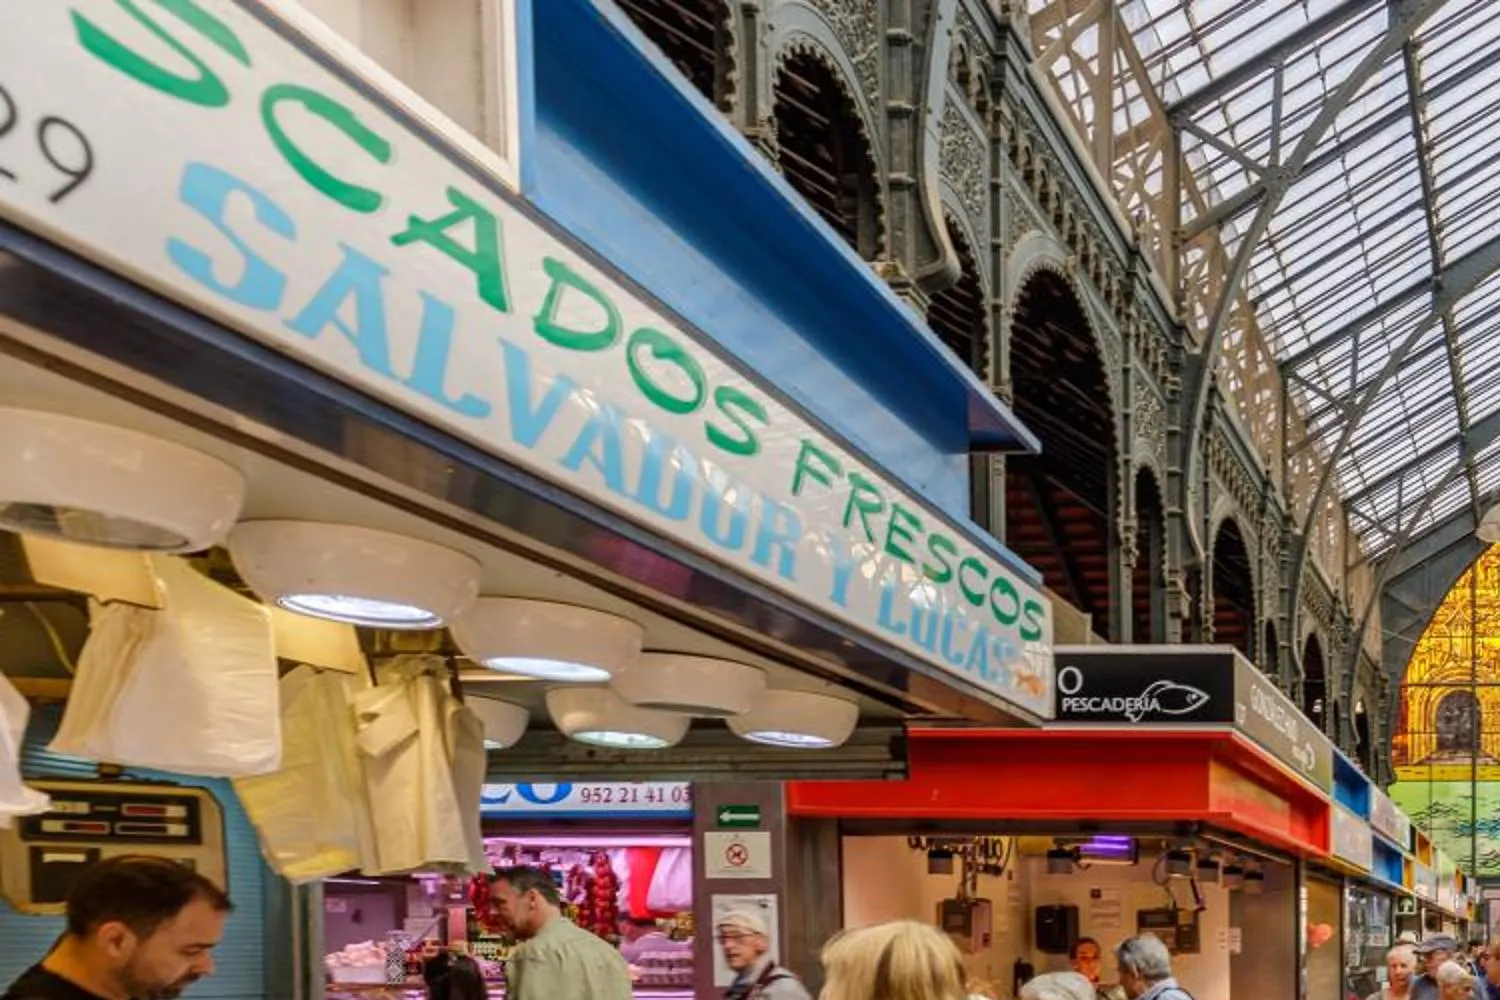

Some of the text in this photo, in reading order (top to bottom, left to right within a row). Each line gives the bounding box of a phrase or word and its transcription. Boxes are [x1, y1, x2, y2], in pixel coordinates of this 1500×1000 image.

[166, 161, 1023, 685] SALVADOR Y LUCAS
[790, 438, 1046, 643] FRESCOS
[580, 787, 613, 803] 952
[619, 787, 639, 803] 21
[644, 787, 664, 803] 41
